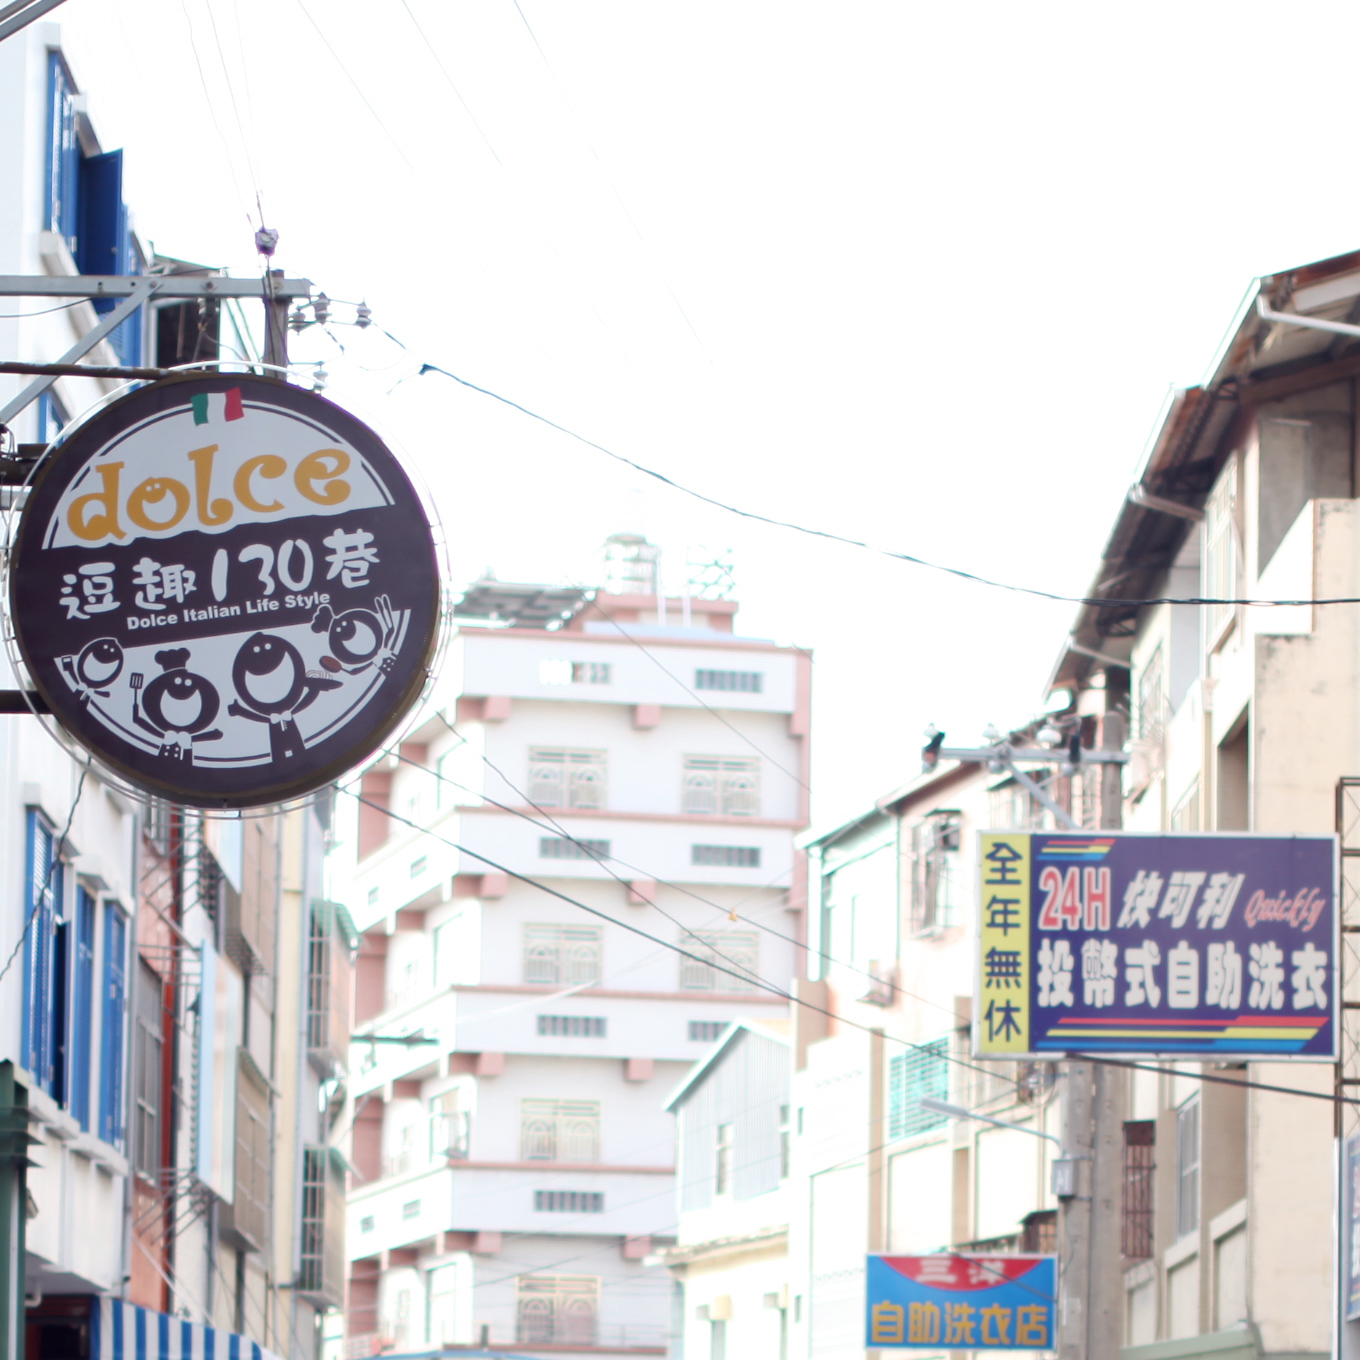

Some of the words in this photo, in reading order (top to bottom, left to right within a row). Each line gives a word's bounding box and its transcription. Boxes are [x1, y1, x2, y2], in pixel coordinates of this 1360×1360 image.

[66, 443, 352, 541] dolce
[58, 527, 381, 621] 逗趣130巷
[126, 613, 178, 630] Dolce
[183, 604, 241, 622] Italian
[245, 598, 280, 614] Life
[284, 591, 331, 610] Style
[1037, 866, 1111, 931] 24H
[1116, 869, 1246, 930] 快可利
[1243, 887, 1326, 932] Quickly
[984, 841, 1023, 1043] 全年無休
[1036, 937, 1328, 1010] 投幣式自助洗衣
[914, 1257, 1006, 1284] 三洋
[871, 1300, 1048, 1346] 自助洗衣店
